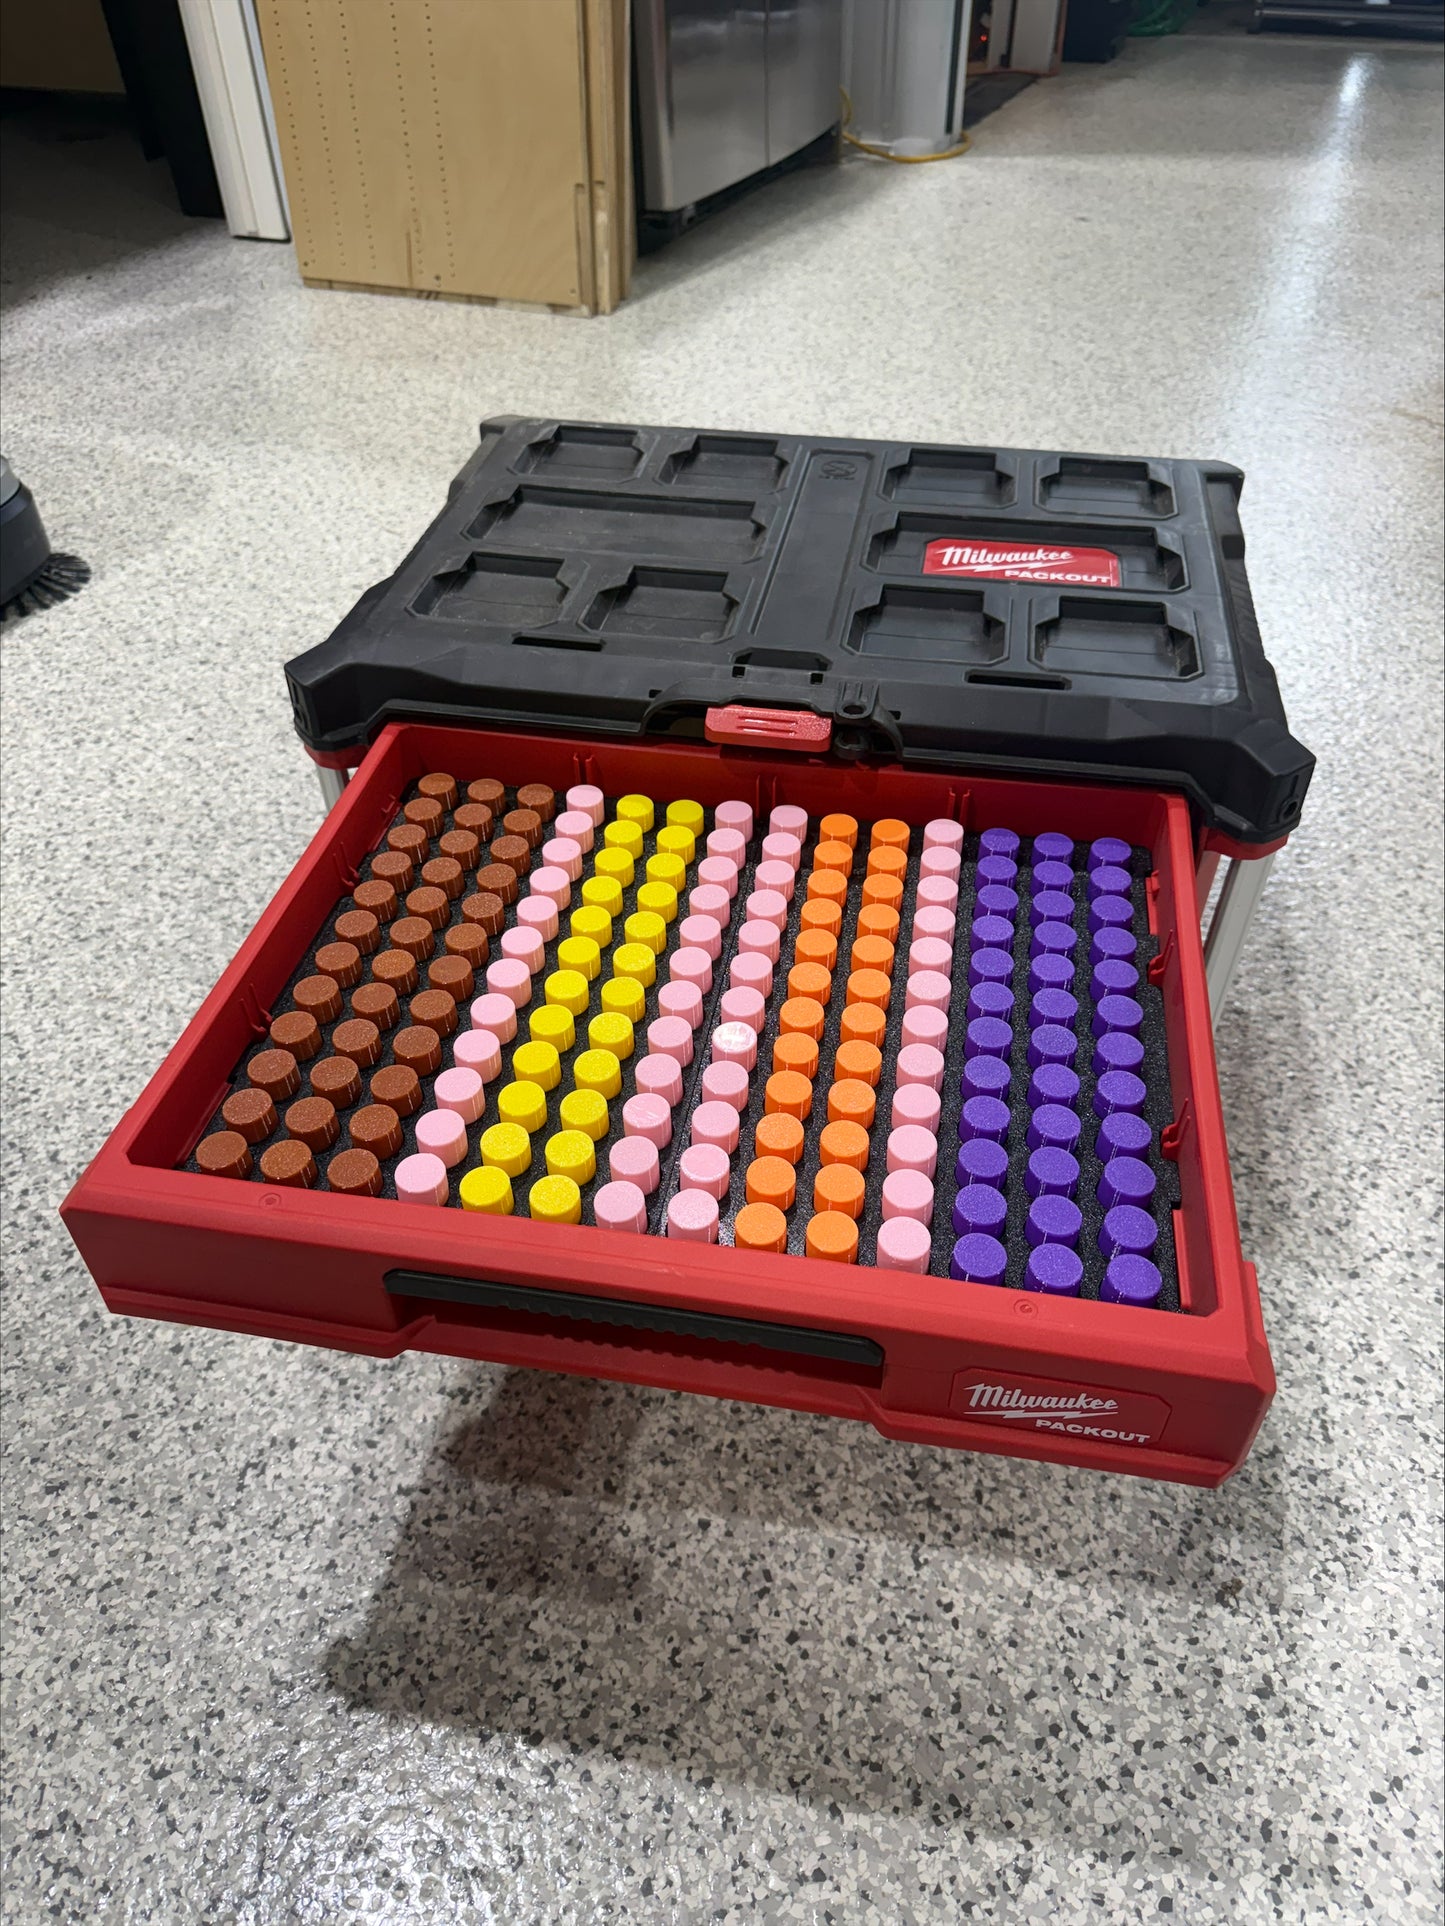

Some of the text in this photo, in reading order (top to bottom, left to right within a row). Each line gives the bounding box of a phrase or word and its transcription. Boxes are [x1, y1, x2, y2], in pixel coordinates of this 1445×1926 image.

[935, 546, 1074, 565] Milwaukee
[1005, 570, 1111, 583] PACKOUT
[964, 1383, 1119, 1409] Milwaukee
[1036, 1419, 1150, 1443] PACKOUT
